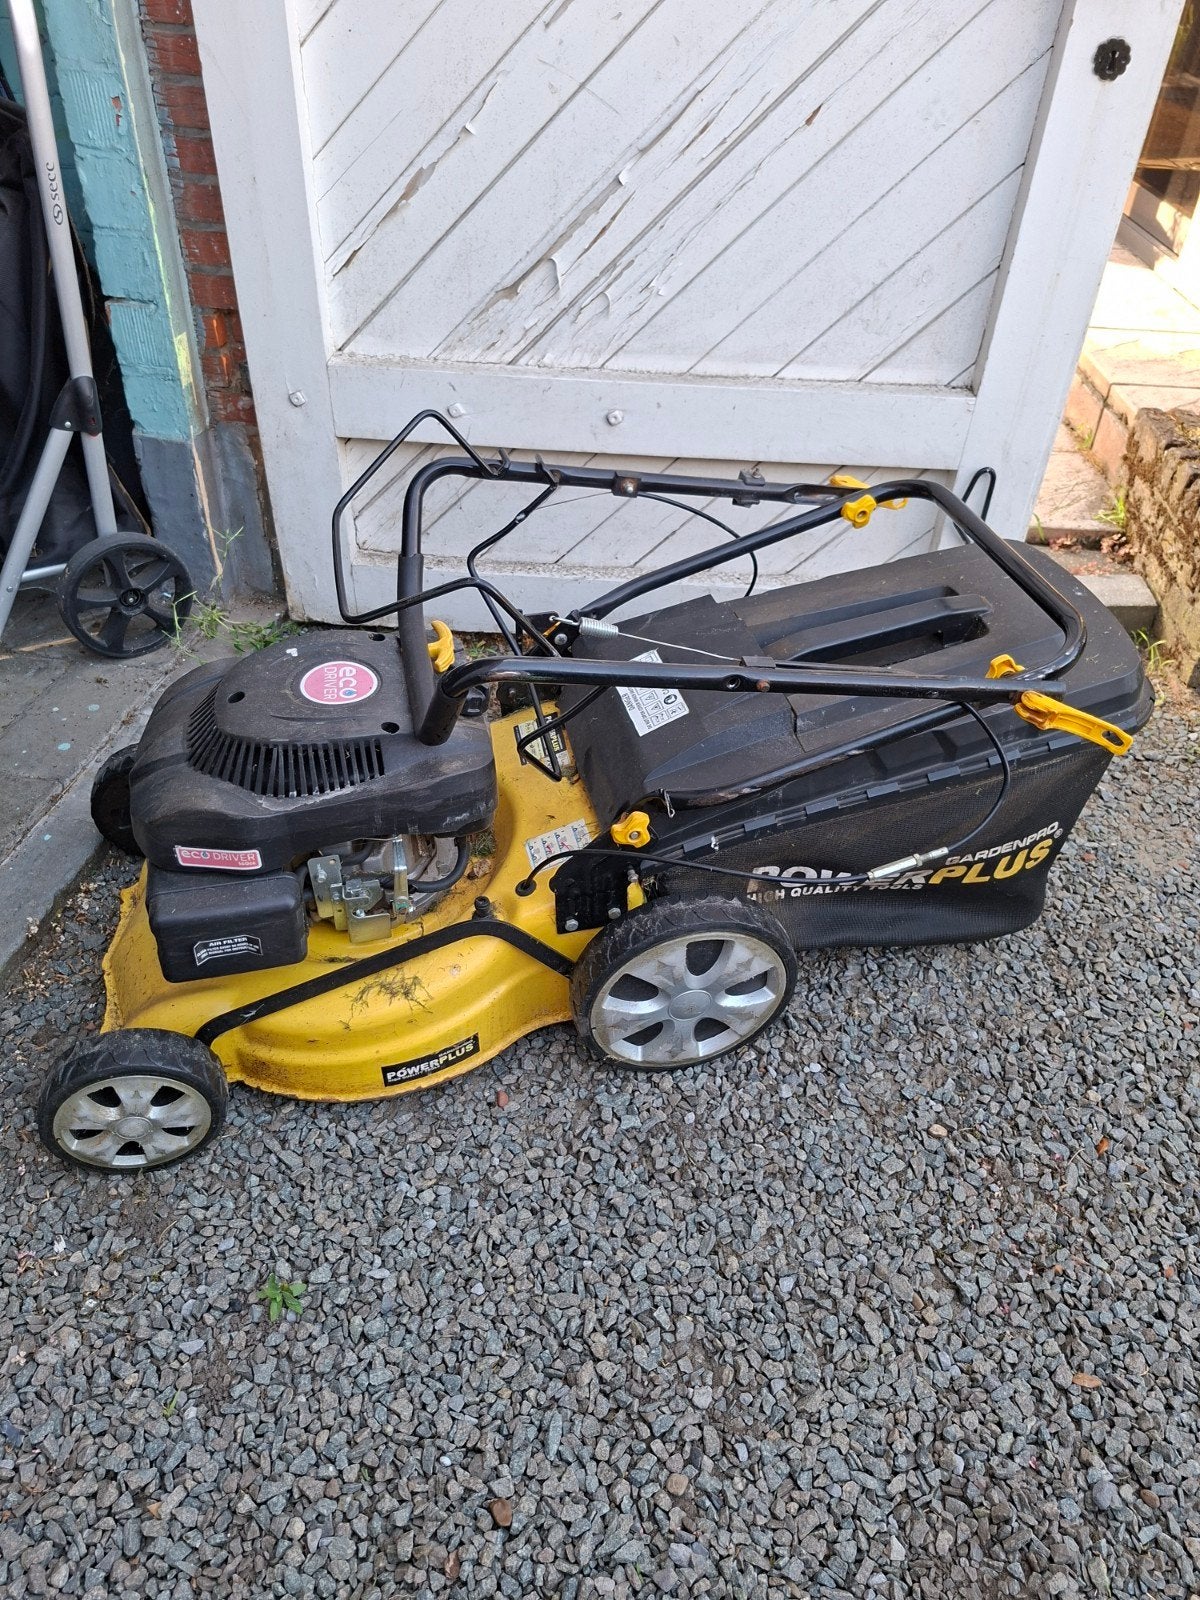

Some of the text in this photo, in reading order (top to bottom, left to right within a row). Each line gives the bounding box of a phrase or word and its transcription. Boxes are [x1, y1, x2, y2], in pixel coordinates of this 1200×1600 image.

[45, 161, 60, 201] secc
[323, 666, 338, 700] DRIVER
[212, 852, 256, 862] DRIVER
[945, 821, 1059, 866] GARDENPRO
[790, 885, 864, 898] QUALITY
[223, 937, 248, 945] FILTER
[386, 1043, 474, 1080] POWERPLUS
